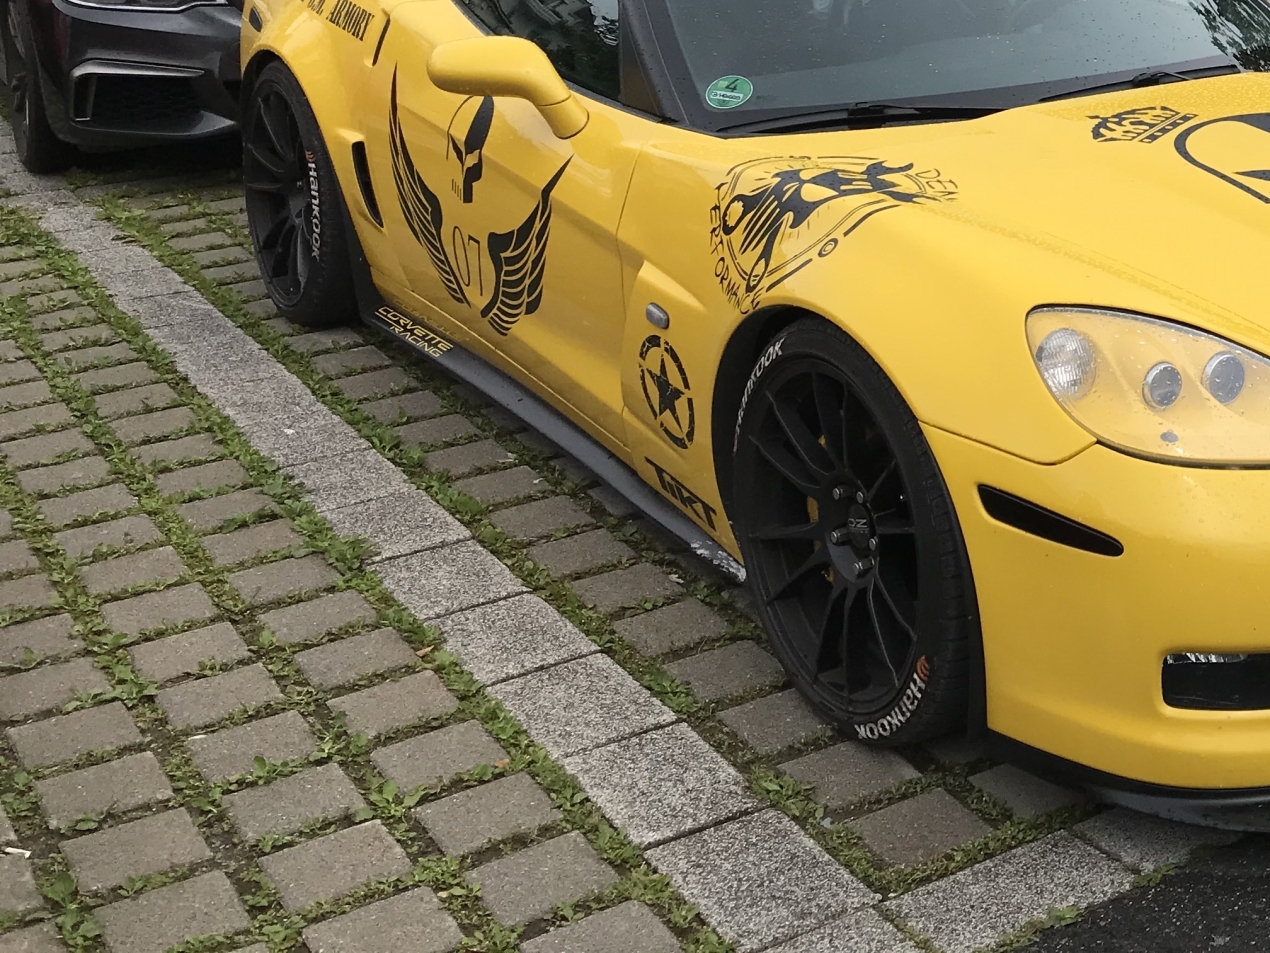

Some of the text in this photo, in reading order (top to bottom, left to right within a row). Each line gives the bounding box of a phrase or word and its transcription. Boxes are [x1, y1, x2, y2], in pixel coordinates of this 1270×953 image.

[453, 225, 483, 297] 07
[378, 306, 454, 351] CORVETTE
[390, 325, 443, 358] RACING
